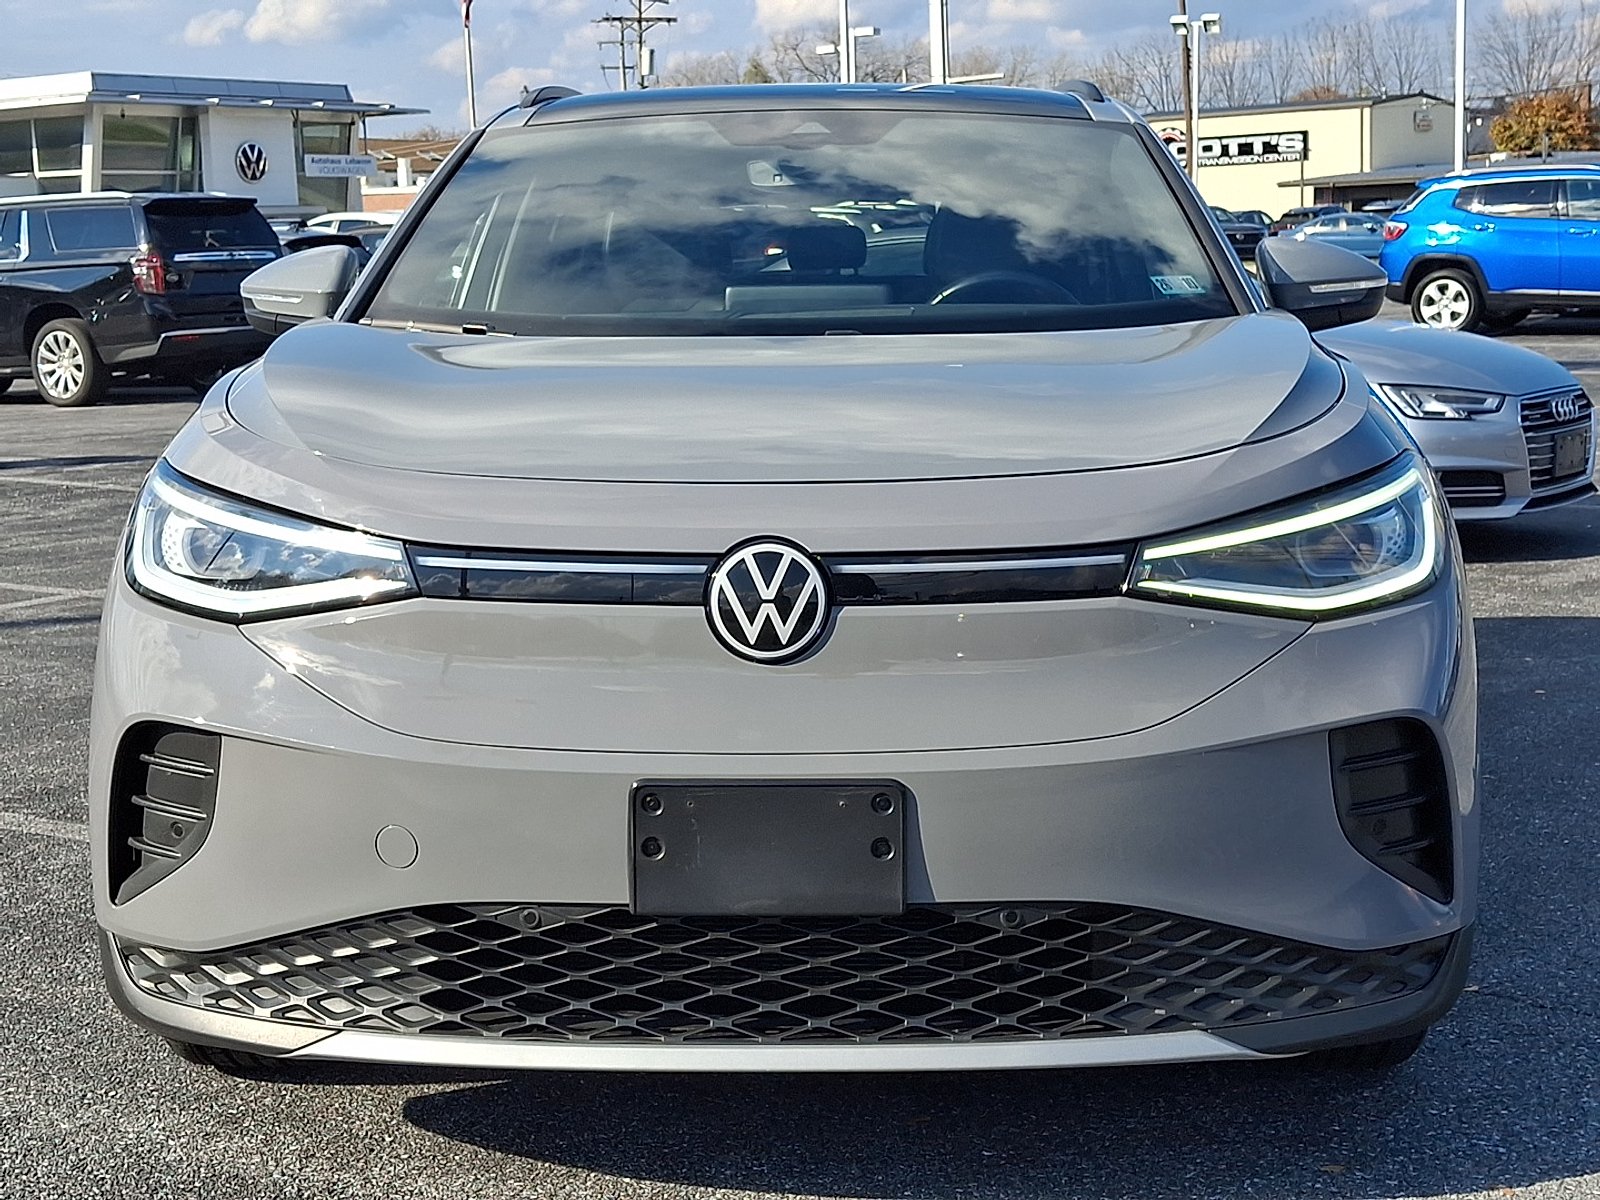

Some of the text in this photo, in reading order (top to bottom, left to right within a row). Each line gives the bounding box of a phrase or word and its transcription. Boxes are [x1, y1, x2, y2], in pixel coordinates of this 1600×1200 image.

[1168, 133, 1304, 160] COTT'S
[311, 157, 341, 165] Autohaus
[1263, 152, 1301, 163] CENTER
[318, 166, 367, 175] VOLKSWAGEN
[714, 548, 822, 652] VW
